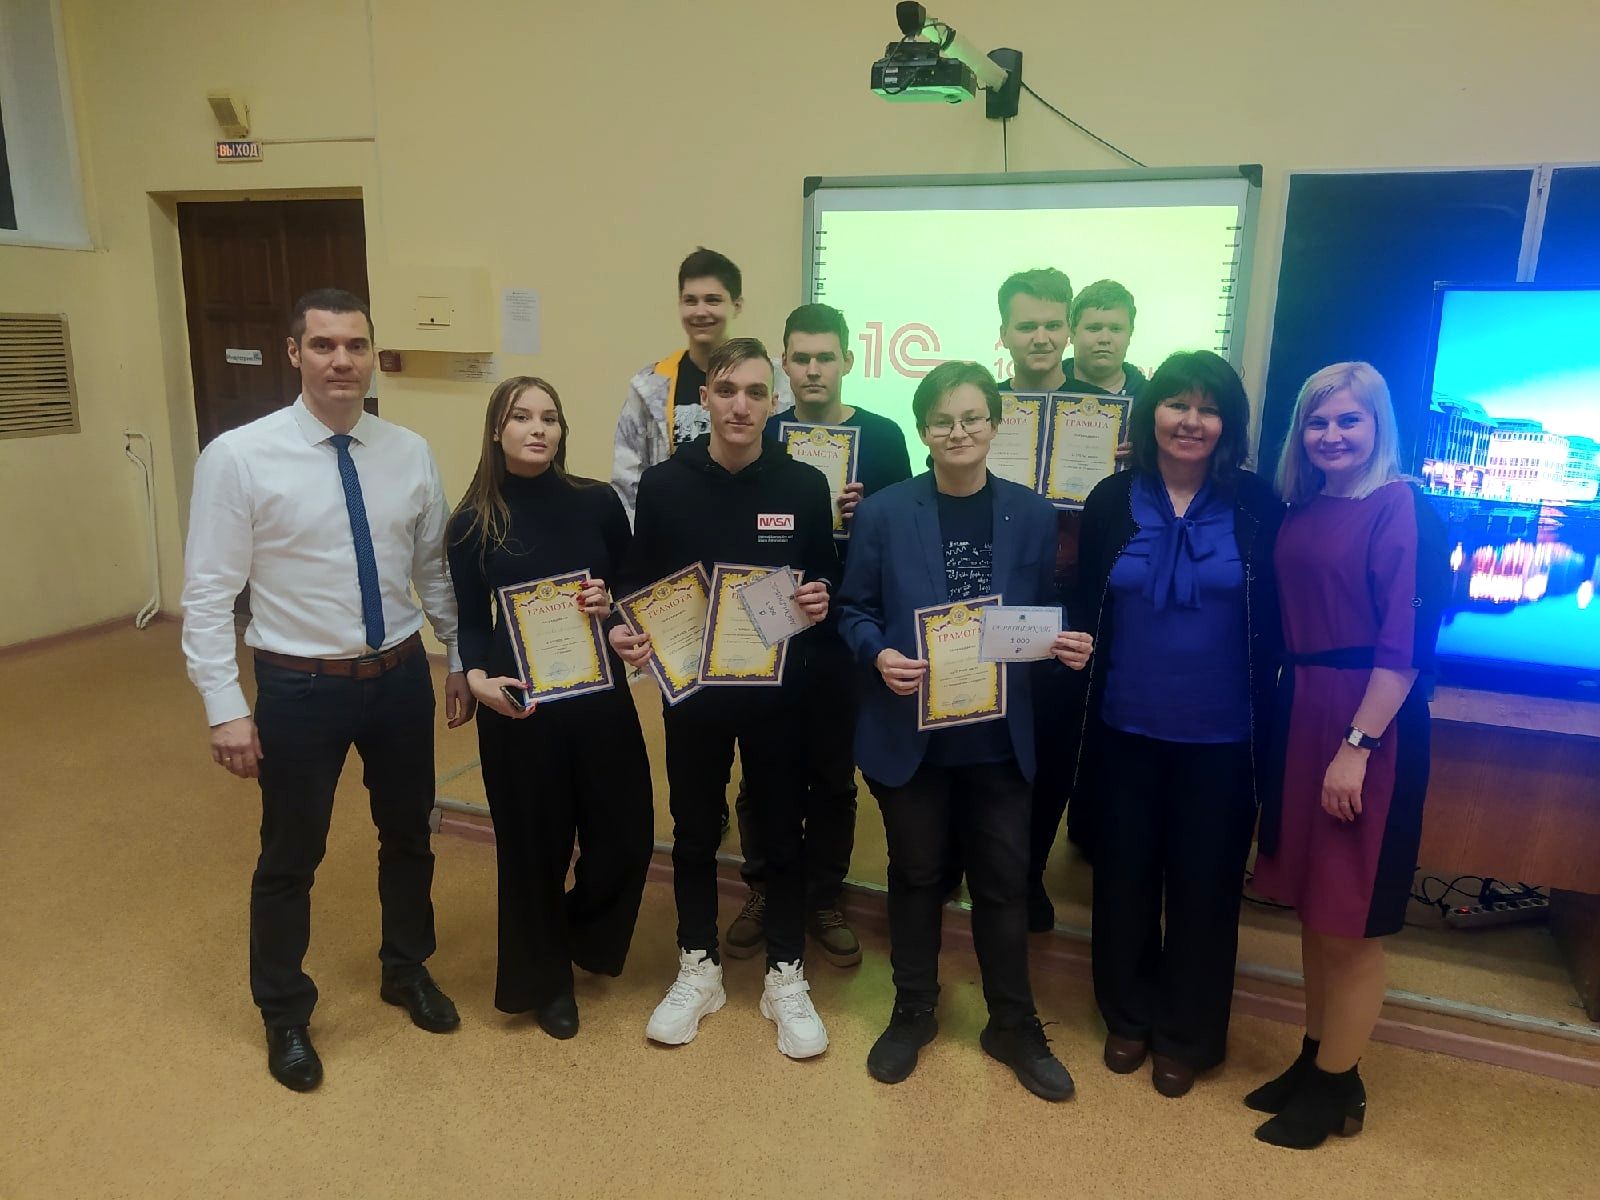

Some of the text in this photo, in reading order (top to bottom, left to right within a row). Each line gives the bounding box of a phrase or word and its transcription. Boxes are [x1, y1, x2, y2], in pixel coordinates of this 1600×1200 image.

[219, 143, 259, 158] ВЫХОД
[759, 517, 792, 527] NASA
[527, 601, 575, 616] ГРАМОТА
[648, 593, 693, 619] ГРАМОТА
